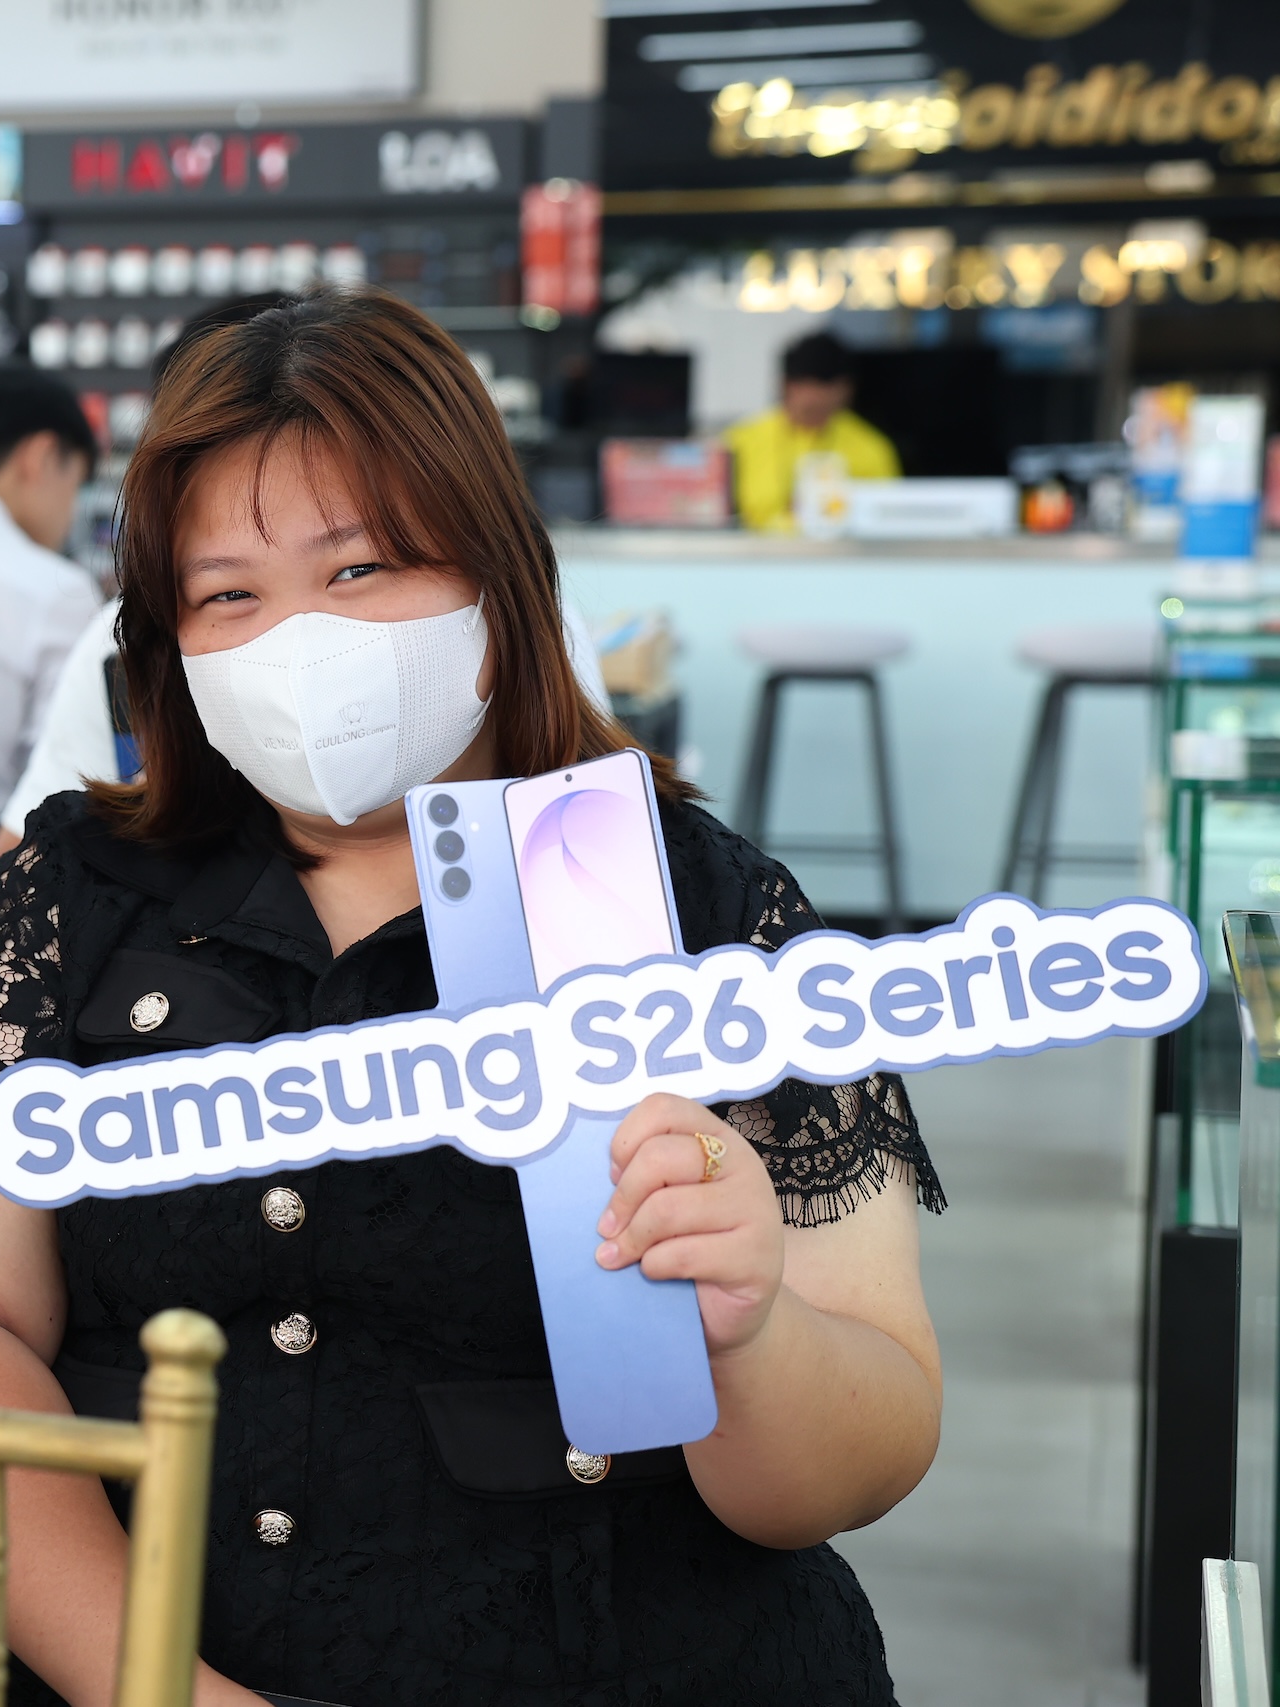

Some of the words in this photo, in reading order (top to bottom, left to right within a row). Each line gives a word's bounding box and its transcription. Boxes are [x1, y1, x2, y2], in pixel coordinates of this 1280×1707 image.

[71, 133, 299, 194] HAVIT
[379, 129, 499, 194] LOA
[259, 737, 278, 751] VIE
[277, 737, 301, 751] Mask
[314, 728, 366, 750] CUULONG
[13, 1028, 543, 1175] Samsung
[570, 977, 767, 1085] S26
[798, 926, 1172, 1049] Series
